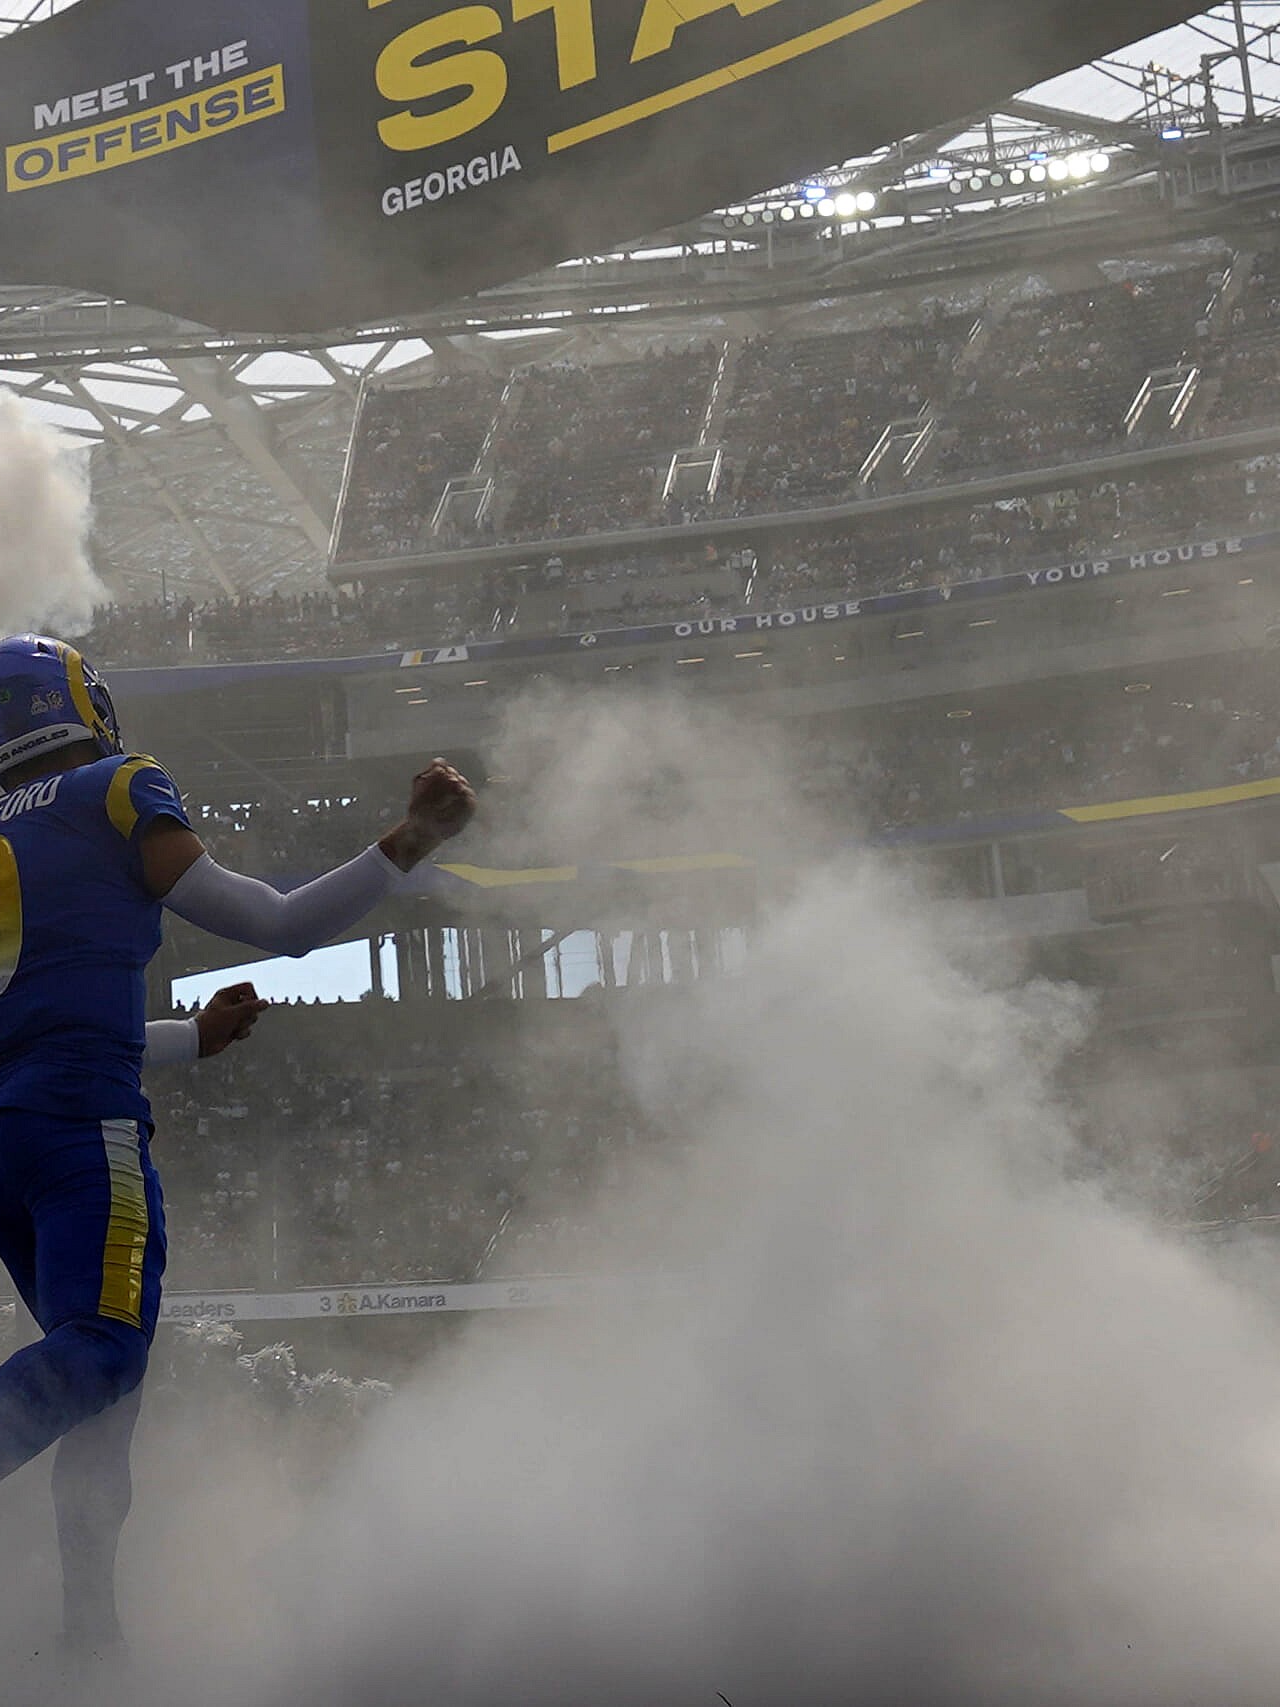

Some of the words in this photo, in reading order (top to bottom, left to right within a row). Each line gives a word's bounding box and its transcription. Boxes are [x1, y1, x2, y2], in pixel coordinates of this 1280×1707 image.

[33, 71, 155, 131] MEET
[164, 38, 249, 92] THE
[13, 76, 278, 182] OFFENSE
[380, 145, 522, 217] GEORGIA
[1026, 561, 1110, 586] YOUR
[1129, 537, 1243, 569] HOUSE
[674, 619, 737, 638] OUR
[755, 602, 861, 629] HOUSE
[11, 729, 70, 757] ANGELES
[160, 1300, 236, 1320] Leaders
[319, 1296, 332, 1313] 3
[359, 1293, 447, 1311] A.Kamara
